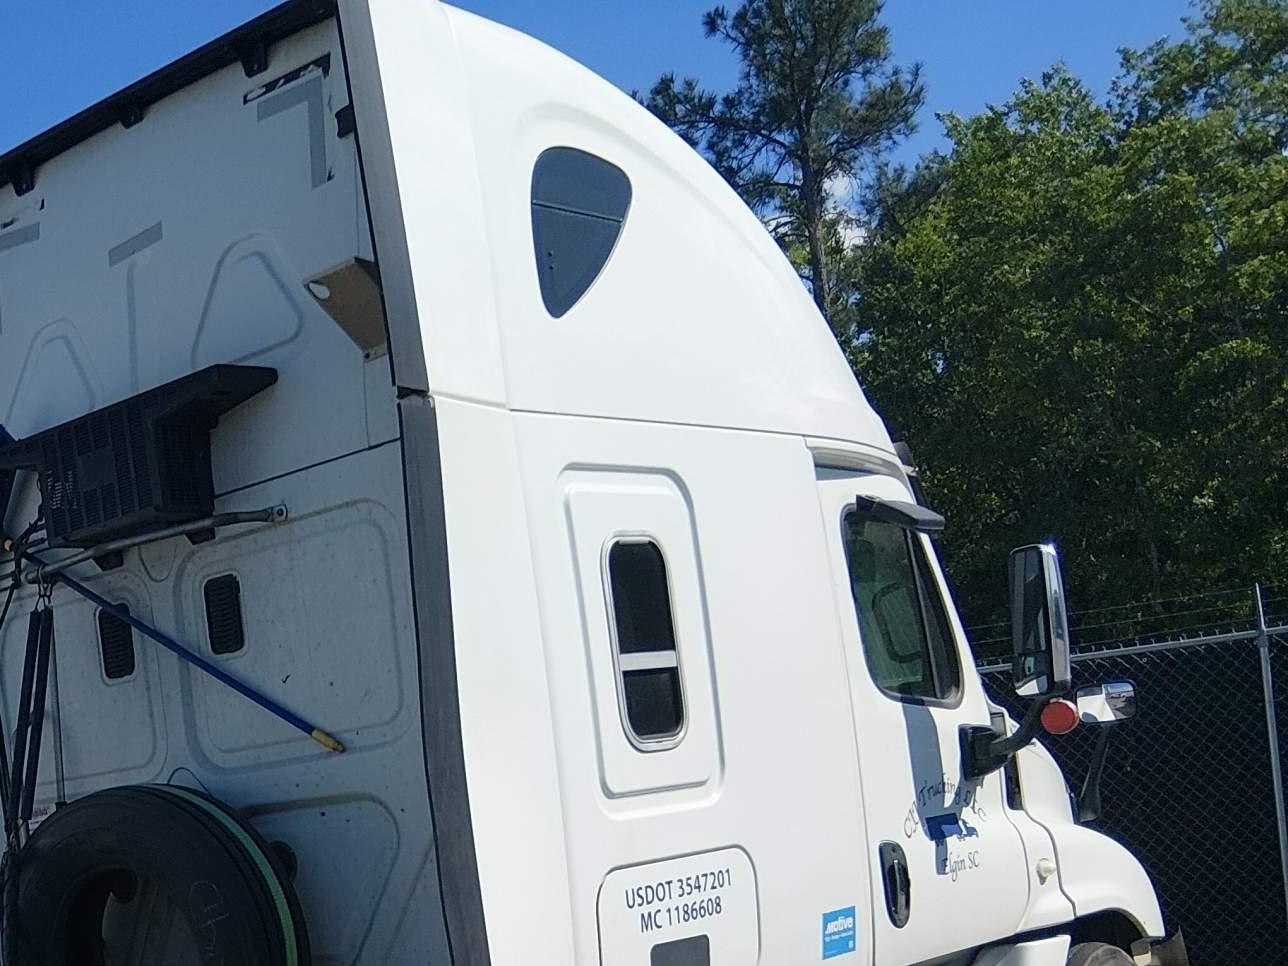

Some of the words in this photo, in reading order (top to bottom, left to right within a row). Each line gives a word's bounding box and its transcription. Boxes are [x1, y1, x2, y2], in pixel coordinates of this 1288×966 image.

[968, 850, 979, 869] SC
[625, 880, 673, 909] USDOT
[677, 868, 731, 898] 3547201
[640, 909, 662, 933] MC
[666, 896, 721, 926] 1186608
